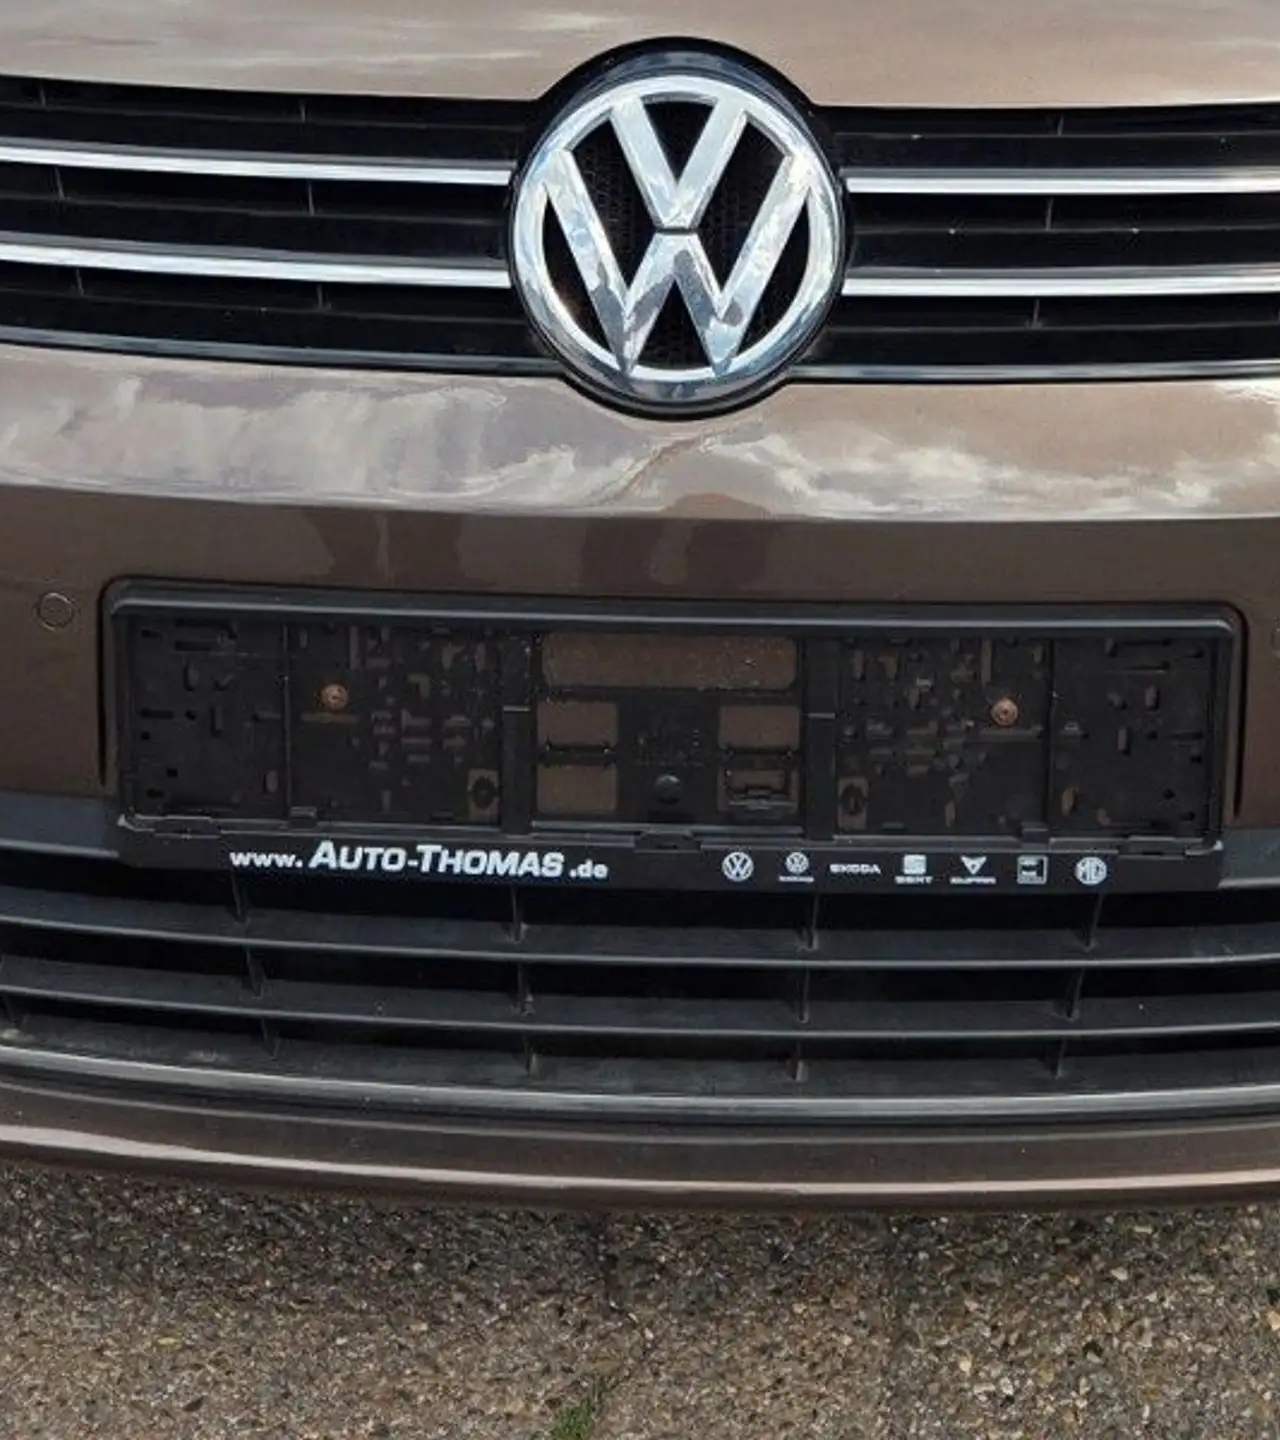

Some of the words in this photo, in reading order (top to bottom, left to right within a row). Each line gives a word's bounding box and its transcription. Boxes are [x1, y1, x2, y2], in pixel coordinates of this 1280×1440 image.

[229, 852, 304, 869] www.
[308, 840, 565, 878] AUTO-THOMAS
[569, 860, 609, 880] .de
